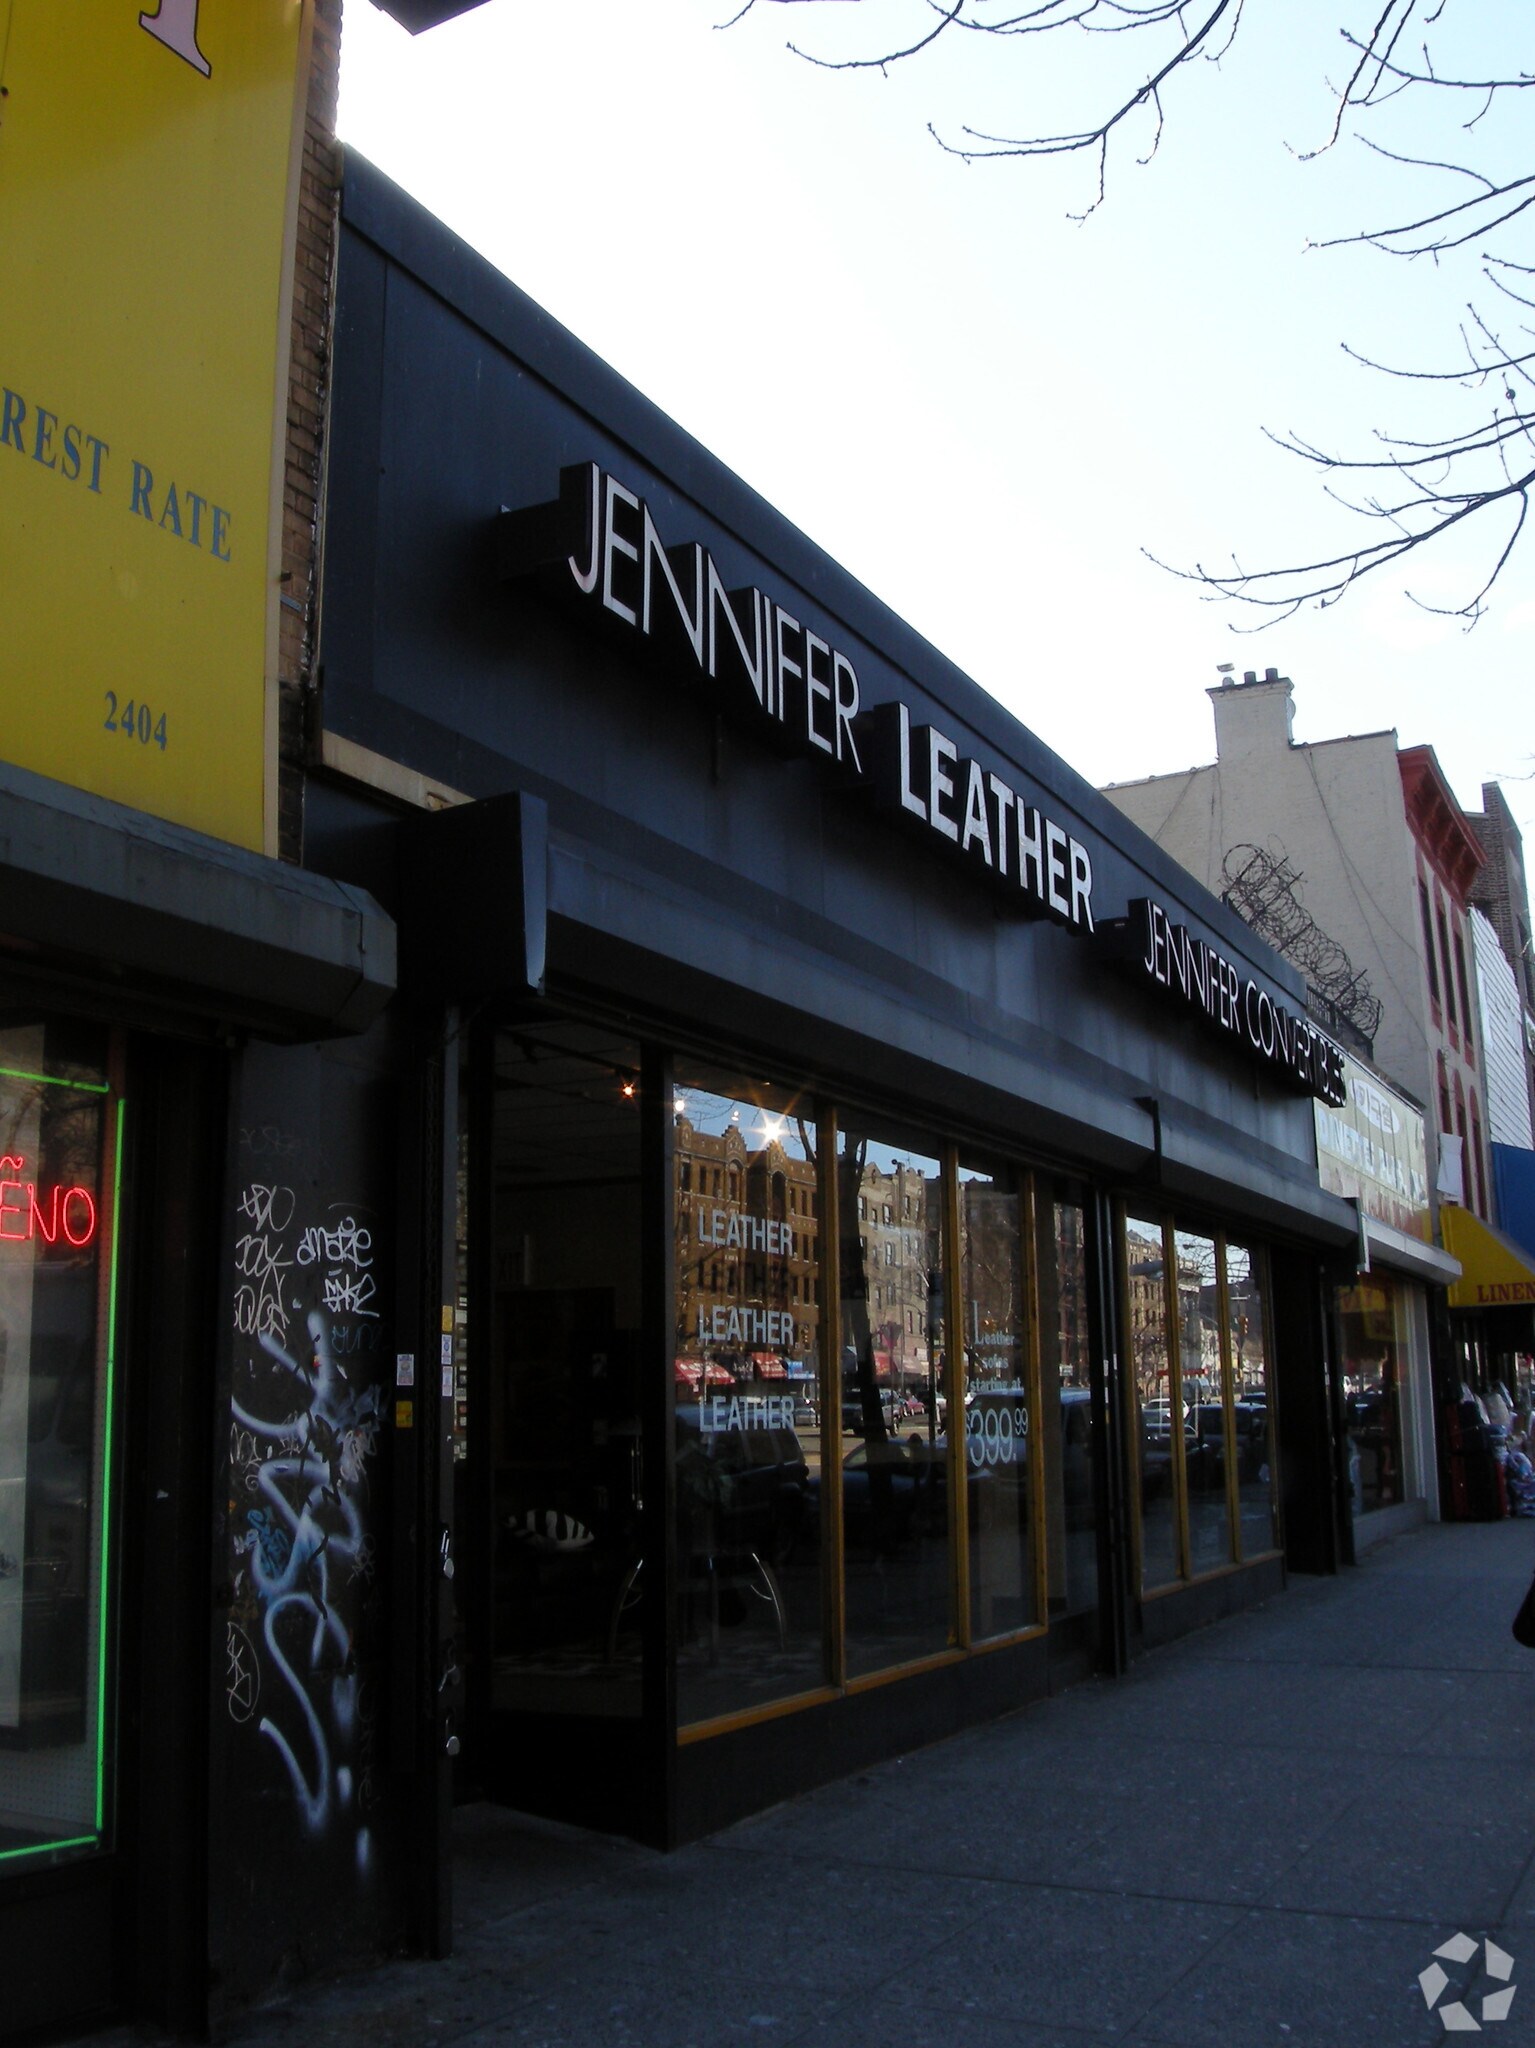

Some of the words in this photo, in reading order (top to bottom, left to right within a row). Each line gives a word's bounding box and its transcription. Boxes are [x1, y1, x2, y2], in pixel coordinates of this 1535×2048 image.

[0, 387, 109, 494] REST
[128, 459, 232, 562] RATE
[103, 690, 168, 752] 2404
[567, 461, 862, 774] JENNIFER
[899, 701, 1095, 934] LEATHER
[1144, 899, 1241, 1034] JENNIFER
[698, 1206, 794, 1257] LEATHER
[699, 1304, 795, 1346] LEATHER
[972, 1299, 1015, 1345] Leather
[969, 1377, 1009, 1393] starting
[700, 1395, 795, 1433] LEATHER
